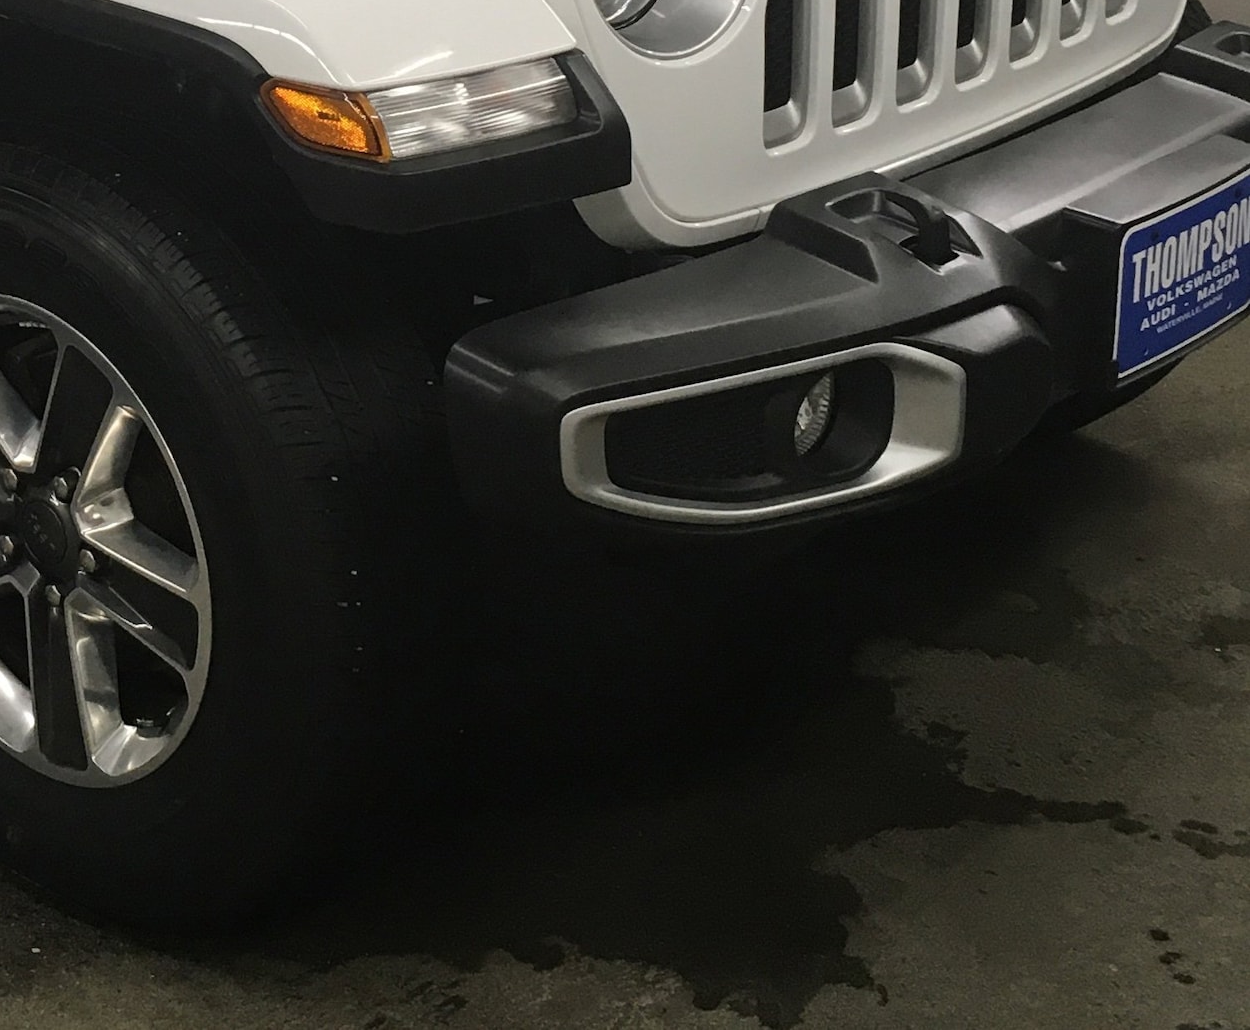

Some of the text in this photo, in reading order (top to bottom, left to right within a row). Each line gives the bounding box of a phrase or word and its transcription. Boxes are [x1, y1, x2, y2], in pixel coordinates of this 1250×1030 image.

[1132, 196, 1250, 304] THOMPSON
[1140, 303, 1176, 332] AUDI
[1196, 268, 1240, 303] MAZDA
[1147, 255, 1238, 312] VOLKSWAGEN
